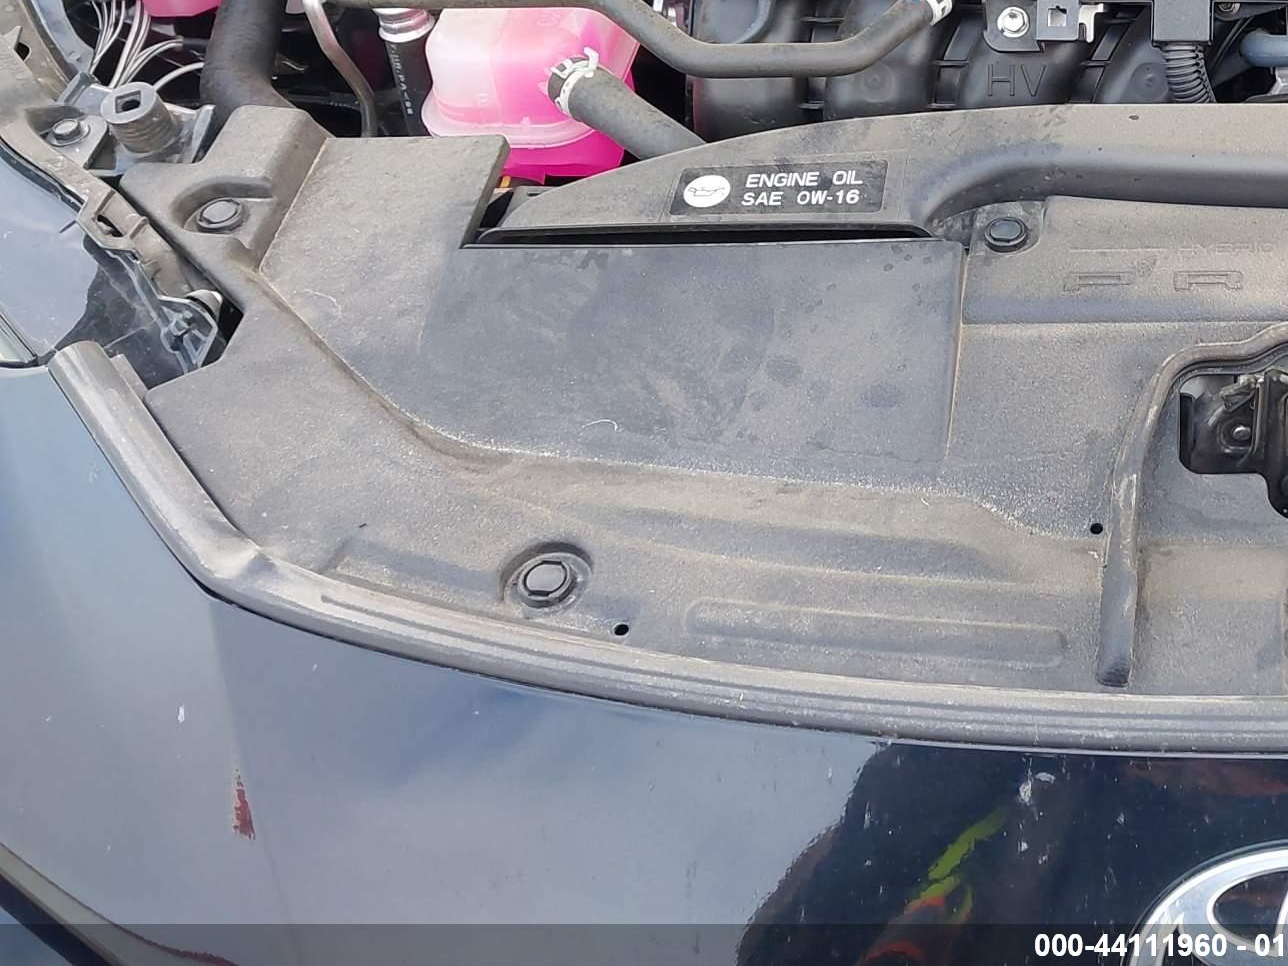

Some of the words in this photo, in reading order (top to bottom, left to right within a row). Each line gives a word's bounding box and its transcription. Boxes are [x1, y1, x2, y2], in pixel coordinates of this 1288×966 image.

[987, 63, 1047, 97] HV
[745, 171, 820, 188] ENGINE
[832, 169, 863, 185] OIL
[741, 191, 783, 206] SAE
[796, 189, 861, 205] 0W-16
